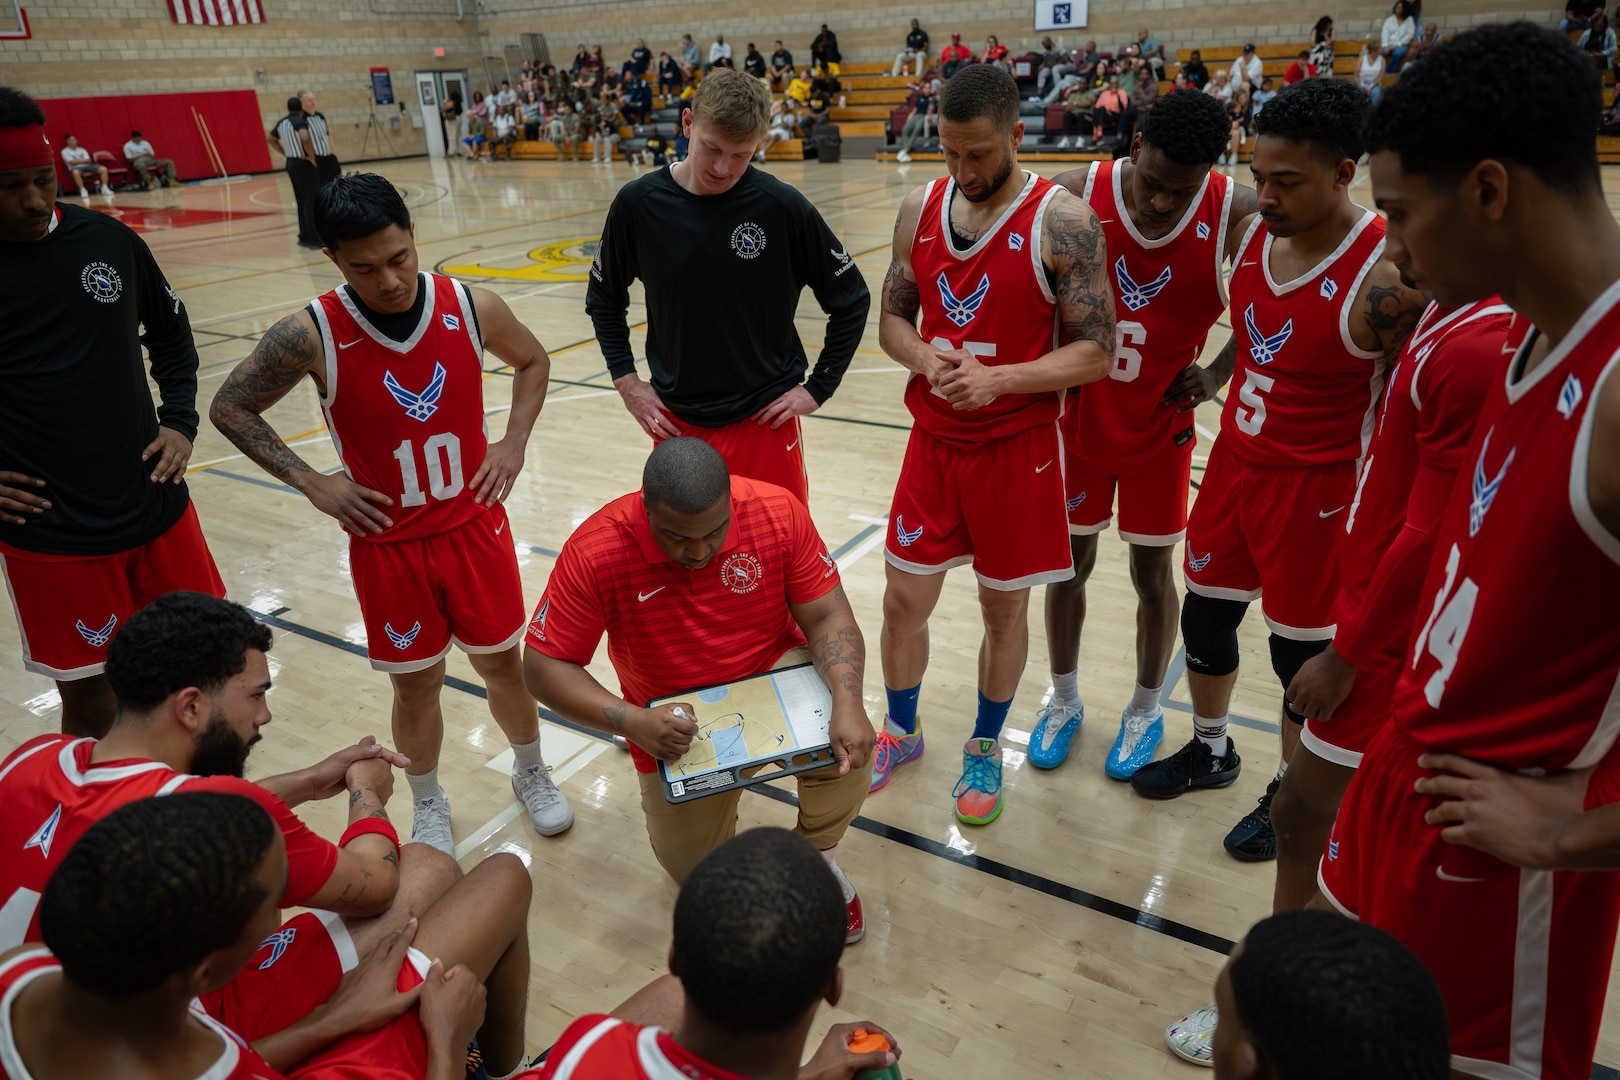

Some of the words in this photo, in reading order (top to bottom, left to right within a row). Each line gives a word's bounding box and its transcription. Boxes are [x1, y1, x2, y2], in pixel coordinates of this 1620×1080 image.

[1109, 320, 1147, 382] 6
[1235, 367, 1275, 437] 5
[393, 432, 464, 508] 10
